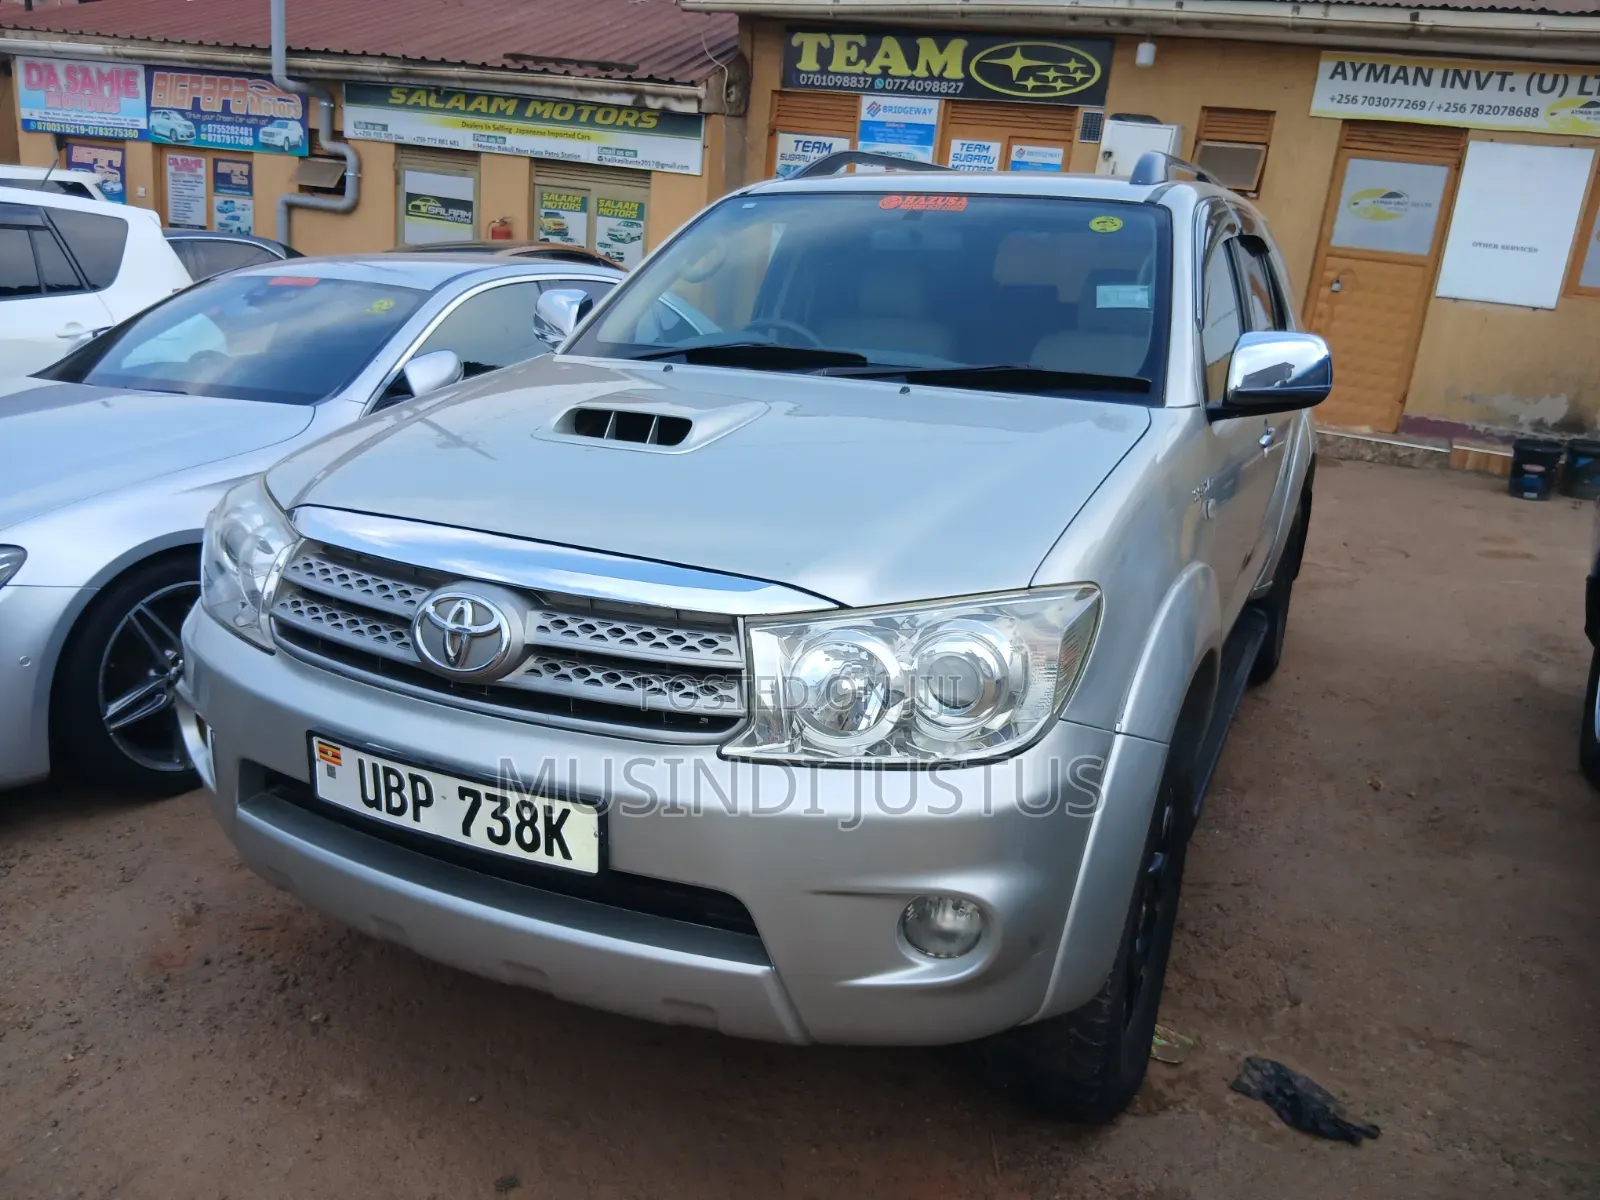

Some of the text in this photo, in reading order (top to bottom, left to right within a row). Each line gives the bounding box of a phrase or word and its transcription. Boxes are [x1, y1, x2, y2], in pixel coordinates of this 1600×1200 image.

[791, 32, 969, 79] TEAM
[24, 61, 62, 92] DA
[1328, 60, 1434, 88] AYMAN
[1440, 68, 1516, 92] INVT.
[1526, 72, 1569, 98] (U)
[800, 73, 964, 94] 0701098837 0774098827
[387, 88, 660, 128] SALAAM MOTORS
[882, 106, 933, 116] BRIDGEWAY
[1329, 94, 1540, 118] +256 703077269 / +256 782078688
[576, 132, 590, 140] Cars
[794, 140, 833, 154] TEAM
[960, 143, 990, 154] TEAM
[780, 153, 811, 162] SUBARU
[952, 153, 996, 164] SUBARU
[542, 192, 582, 203] SALAAM
[542, 200, 582, 210] MOTORS
[598, 200, 638, 210] SALAAM
[428, 206, 472, 218] SALAAM
[598, 208, 638, 218] MOTORS
[1472, 241, 1538, 253] OTHER SERVICES
[358, 758, 573, 860] UBP 738K
